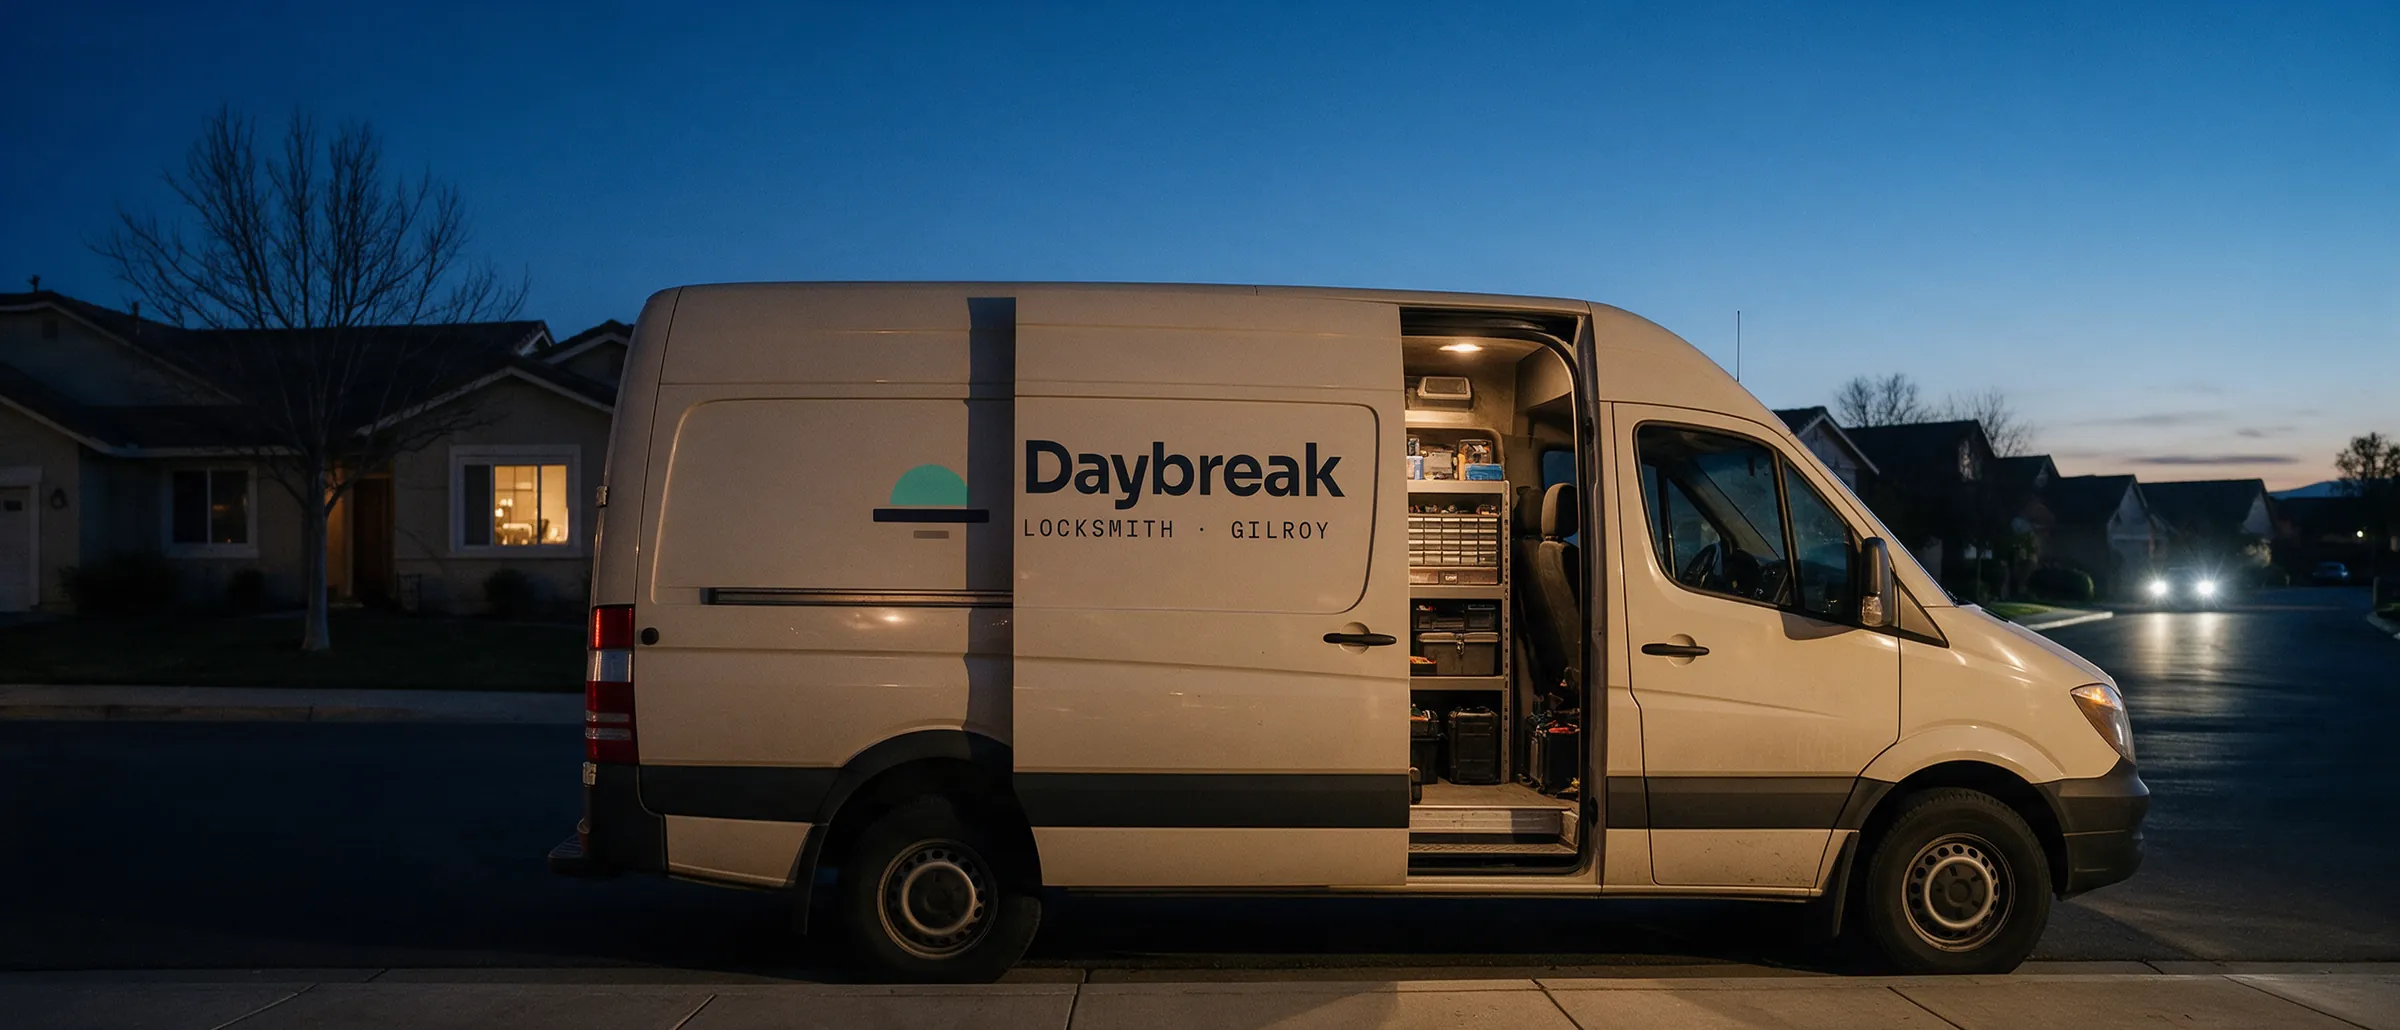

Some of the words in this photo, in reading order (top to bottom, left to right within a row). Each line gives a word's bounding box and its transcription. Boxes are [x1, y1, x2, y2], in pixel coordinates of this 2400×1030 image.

[1025, 439, 1345, 510] Daybreak
[1023, 518, 1173, 538] LOCKSMITH
[1231, 520, 1329, 540] GILROY
